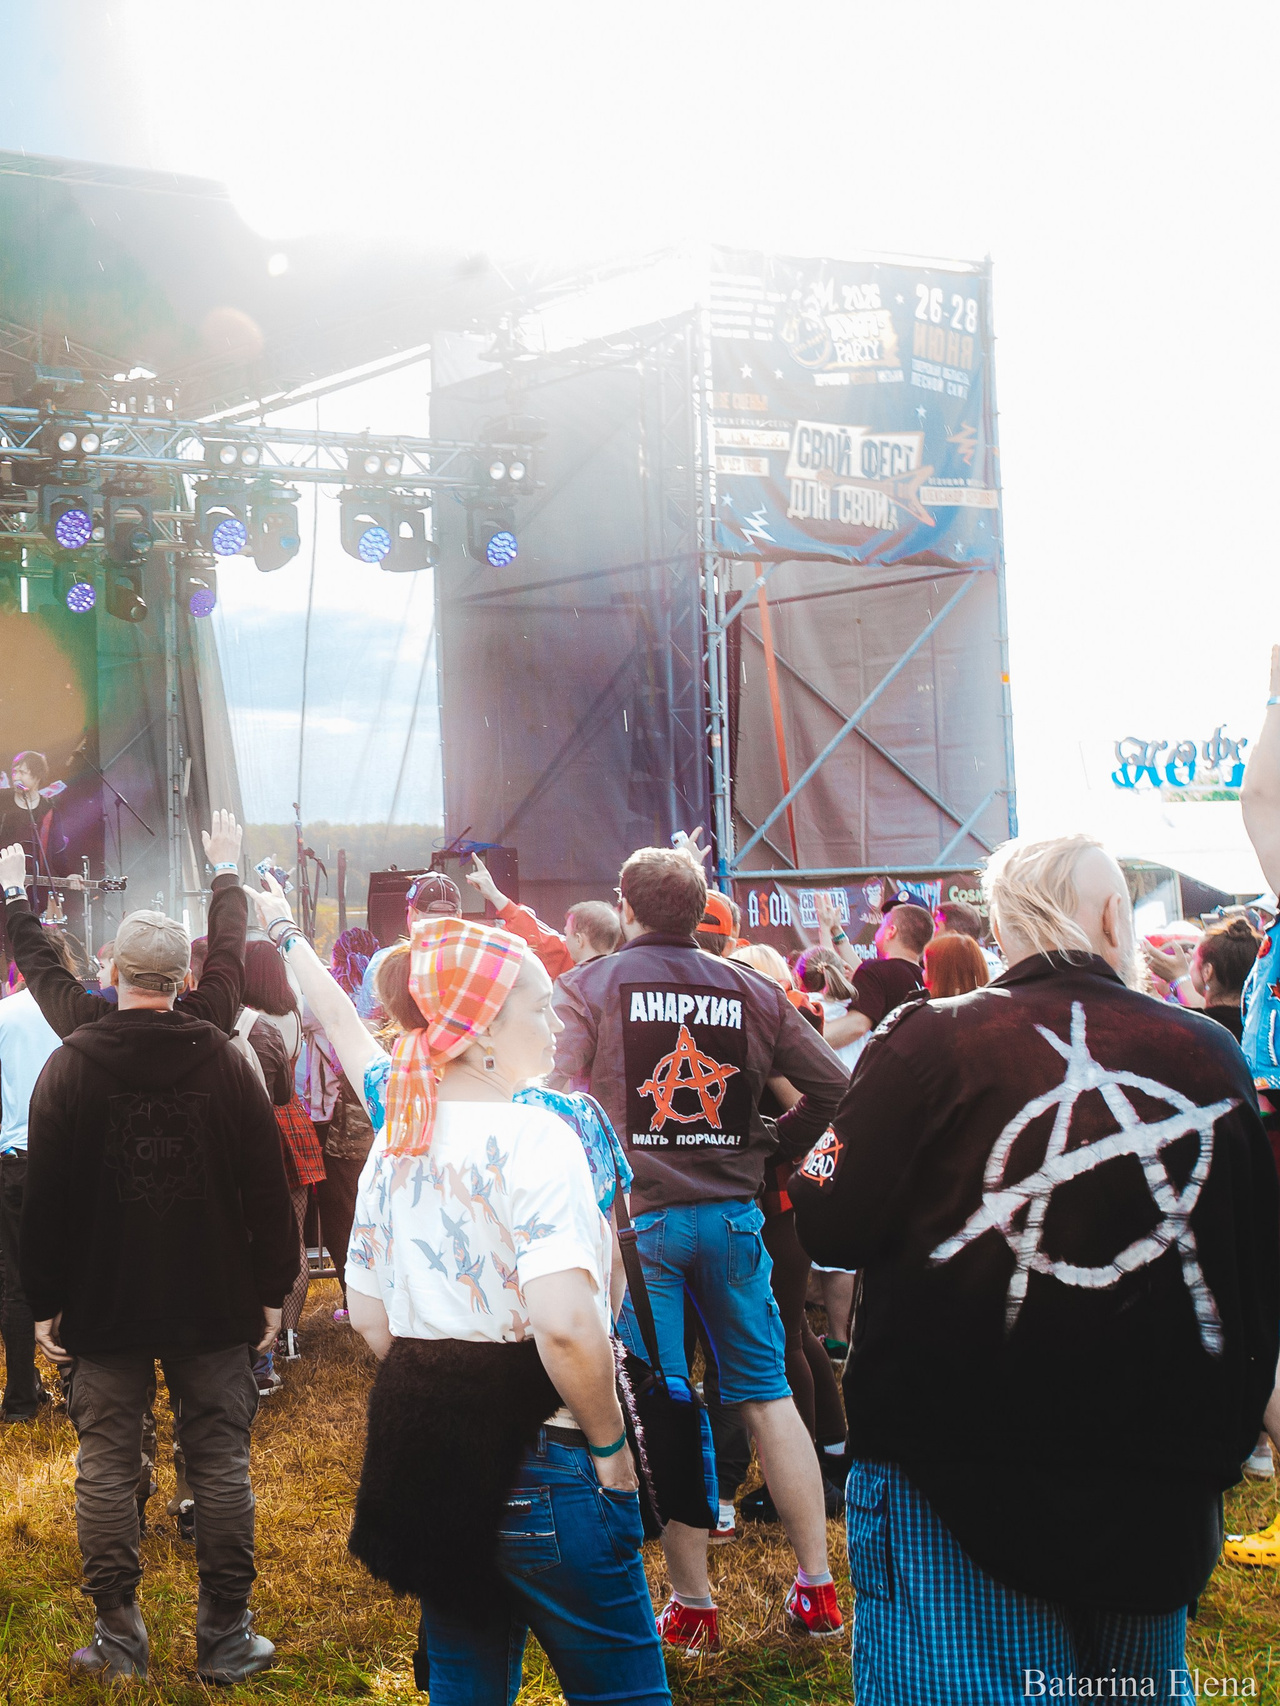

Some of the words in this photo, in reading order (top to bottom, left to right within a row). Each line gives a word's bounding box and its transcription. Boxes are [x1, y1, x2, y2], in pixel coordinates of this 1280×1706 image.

[914, 283, 978, 334] 26-28
[913, 321, 973, 370] ИЮНЯ
[797, 426, 852, 476] СВОЙ
[860, 436, 915, 480] ФЕСТ
[786, 479, 832, 520] ДЛЯ
[629, 992, 743, 1030] АНАРХИЯ
[632, 1133, 669, 1145] МАТЬ
[676, 1133, 742, 1146] ПОРЯДКА!
